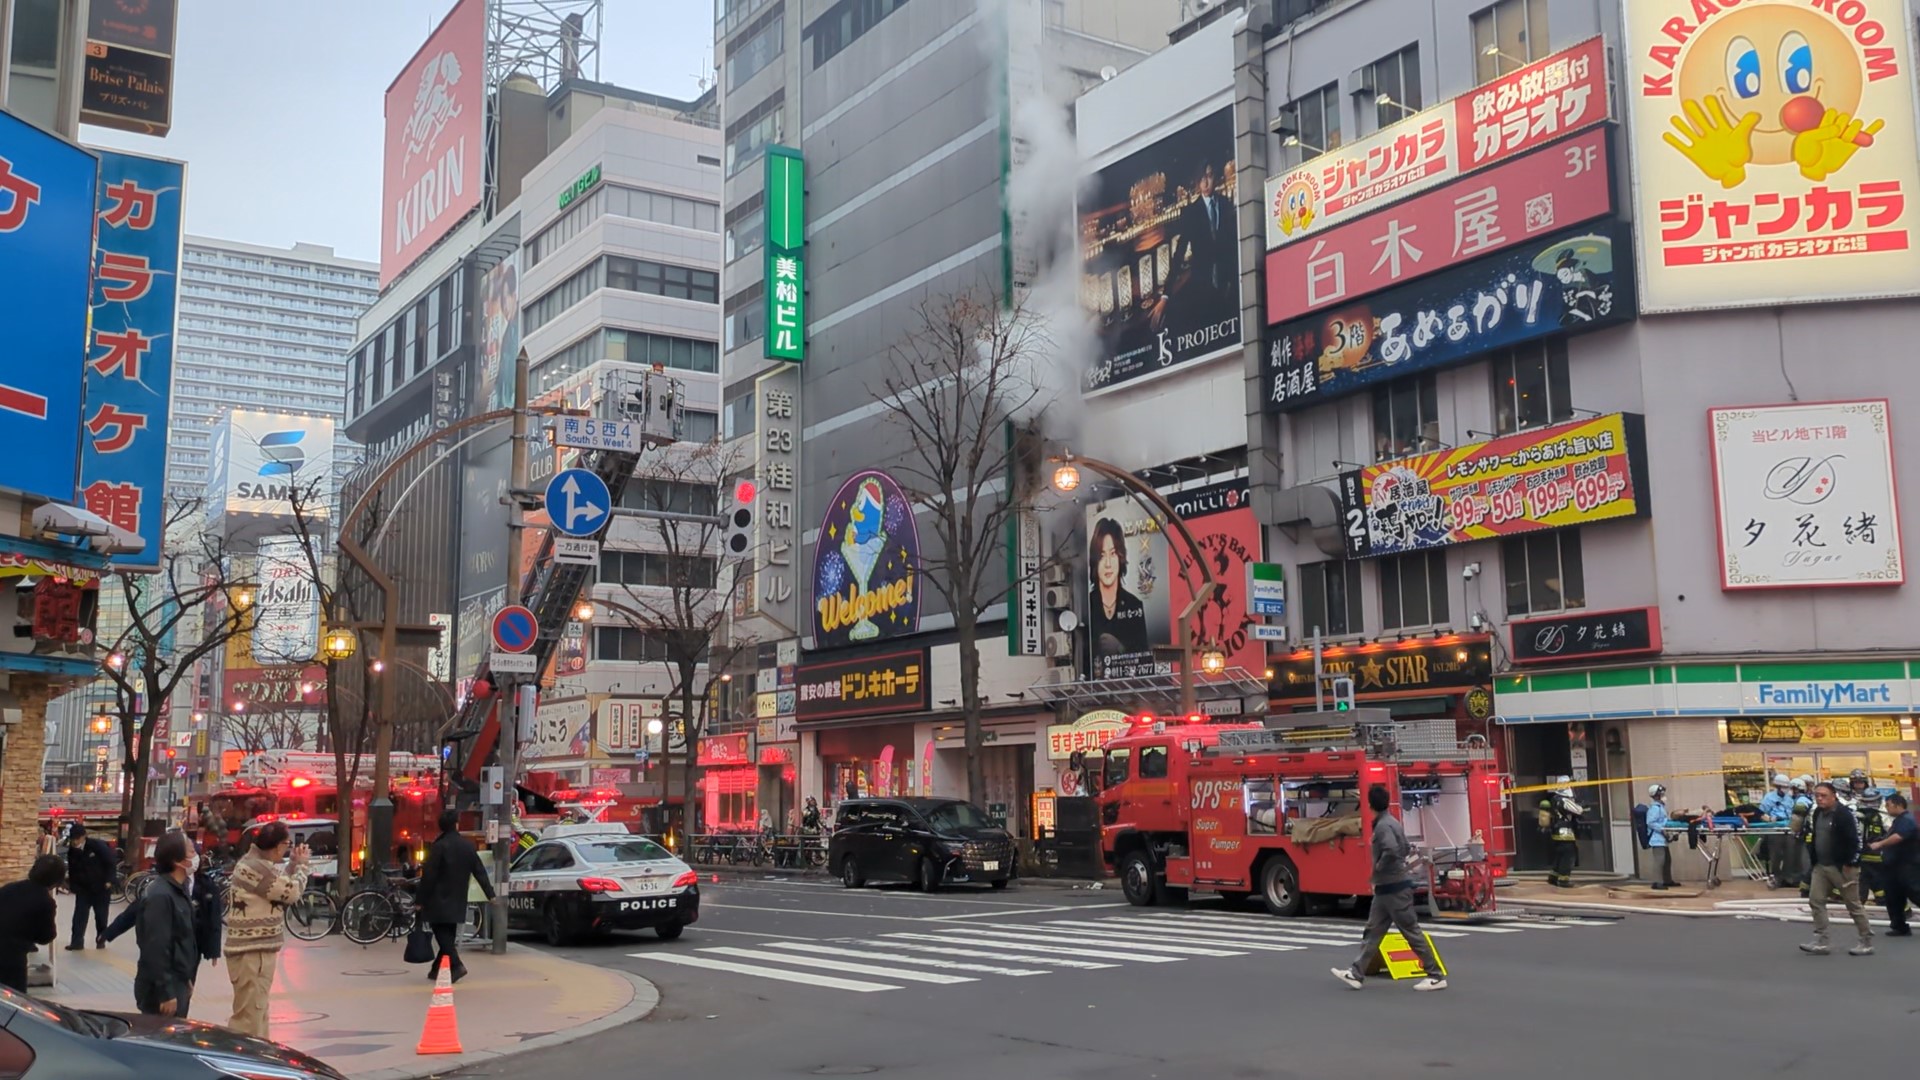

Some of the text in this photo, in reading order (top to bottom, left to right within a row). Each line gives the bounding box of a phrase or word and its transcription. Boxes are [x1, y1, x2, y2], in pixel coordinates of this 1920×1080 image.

[128, 75, 164, 94] Palais
[1473, 55, 1589, 123] 飲み放題付
[1474, 86, 1592, 163] カラオケ
[1323, 118, 1447, 195] ジャンカラ
[1565, 145, 1597, 178] 3F
[396, 136, 465, 254] KIRIN
[1343, 166, 1426, 208] ジャンボカラオケ広場
[1660, 180, 1905, 241] ジャンカラ
[1307, 186, 1507, 307] 白木屋
[1702, 235, 1868, 262] ジャンボカラオケ広場
[776, 256, 798, 351] 美松ビル
[1177, 316, 1239, 352] PROJECT
[1328, 320, 1365, 355] 3階
[84, 179, 158, 535] カラオケ館
[1271, 361, 1317, 403] 居酒屋
[565, 433, 591, 445] South
[592, 436, 599, 446] 5
[603, 438, 625, 448] West
[1752, 425, 1847, 444] 当ビル地下1階
[530, 455, 553, 482] CLUB
[1447, 431, 1614, 478] レモンサワーとからあげの旨い店
[766, 387, 792, 603] 第23桂和ビル
[1743, 512, 1879, 548] 夕花緒
[261, 579, 311, 604] Asahi
[819, 564, 915, 633] Welcome!
[1254, 585, 1282, 594] FamilyMart
[1266, 604, 1282, 613] たばこ
[1576, 621, 1626, 642] 夕花緒
[1386, 654, 1429, 685] STAR
[1759, 682, 1891, 710] FamilyMart
[1191, 780, 1223, 809] SPS
[1196, 819, 1219, 832] Super
[1210, 838, 1240, 851] Pumper
[620, 898, 677, 911] POLICE
